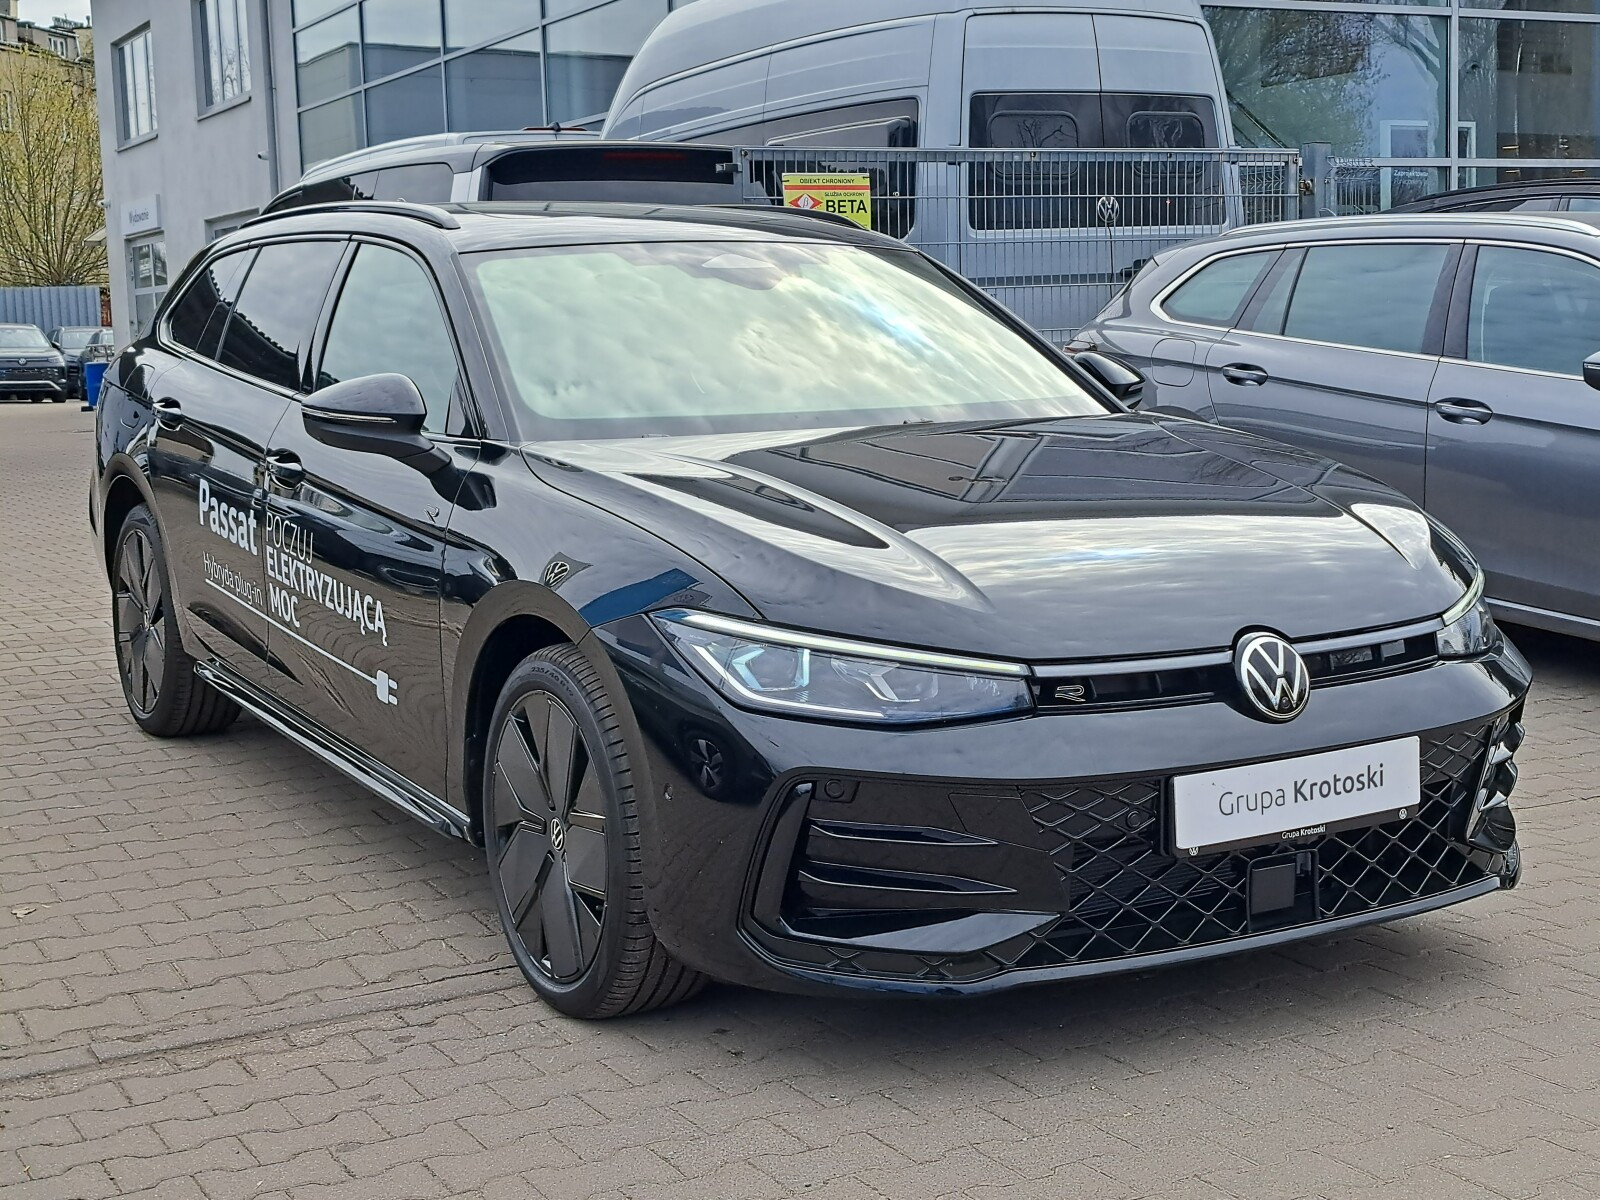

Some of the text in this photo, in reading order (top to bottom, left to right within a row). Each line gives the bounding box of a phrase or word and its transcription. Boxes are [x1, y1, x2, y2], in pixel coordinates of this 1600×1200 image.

[826, 200, 867, 213] BETA
[199, 478, 258, 556] Passat
[265, 511, 314, 564] POCZUJ
[203, 550, 263, 606] Hybryda plug-in
[265, 544, 388, 647] ELEKTRYZUJĄCĄ
[268, 582, 301, 628] MOC
[1218, 762, 1384, 816] Grupa Krotoski
[1281, 824, 1326, 840] Grupa Krotoski
